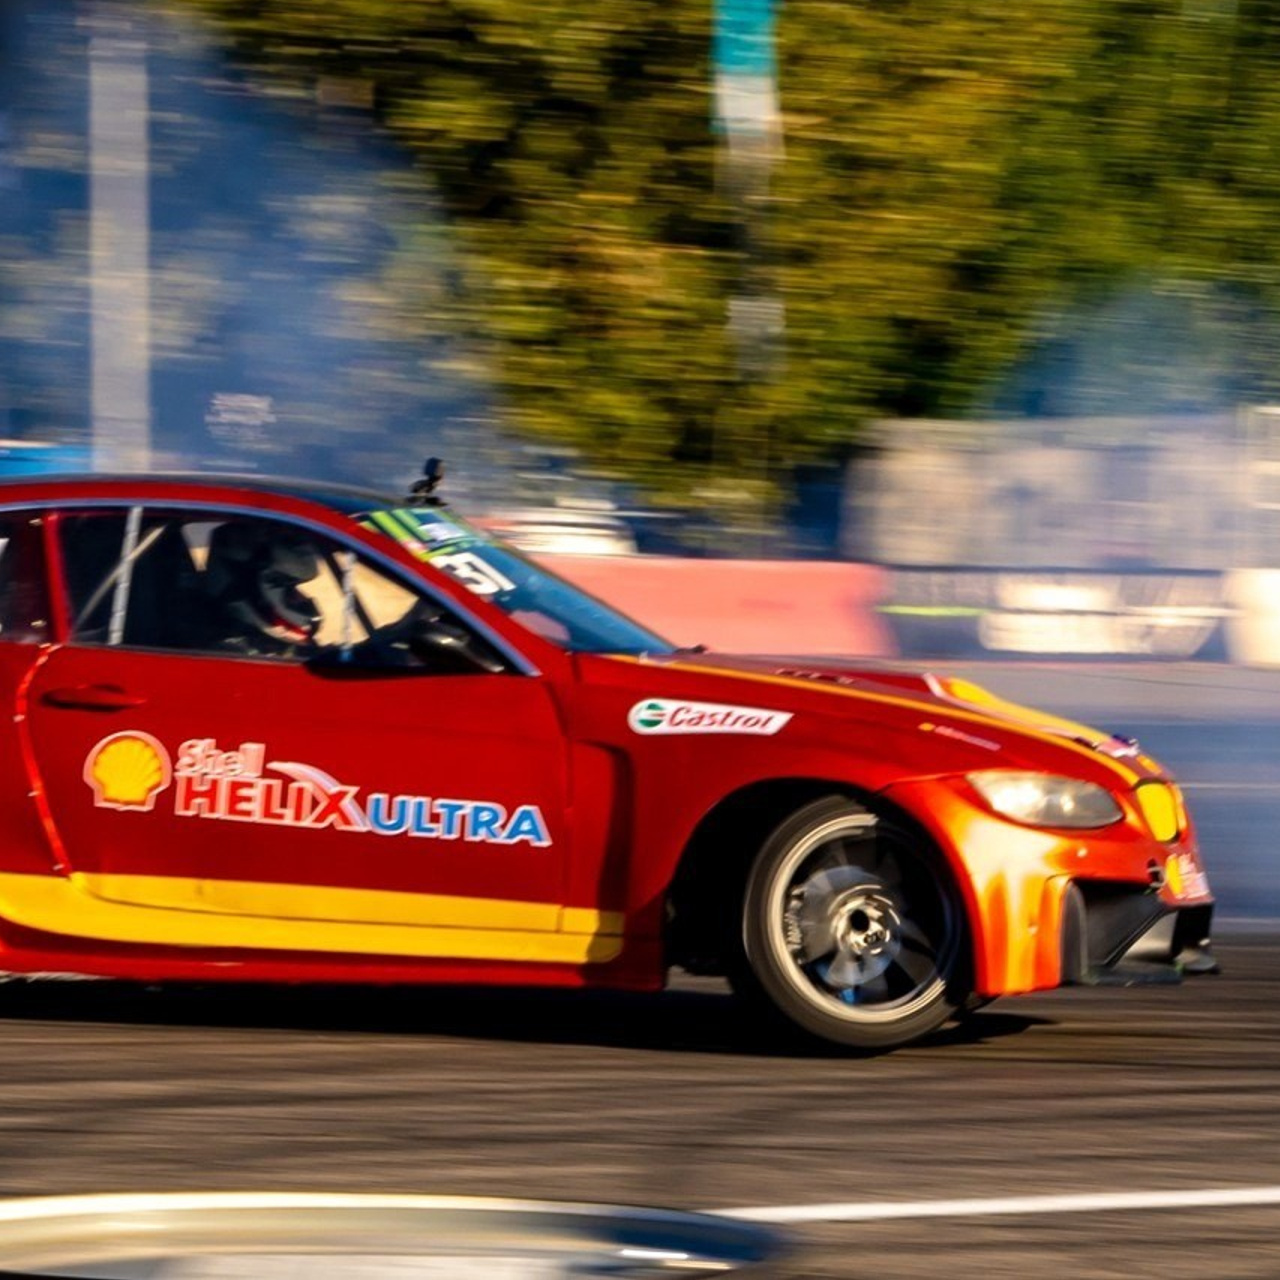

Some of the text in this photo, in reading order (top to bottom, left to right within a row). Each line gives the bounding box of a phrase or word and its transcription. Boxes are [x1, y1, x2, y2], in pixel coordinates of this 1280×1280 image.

[668, 705, 775, 727] Castrol
[174, 738, 266, 777] Shell
[175, 773, 552, 847] HELIX ULTRA
